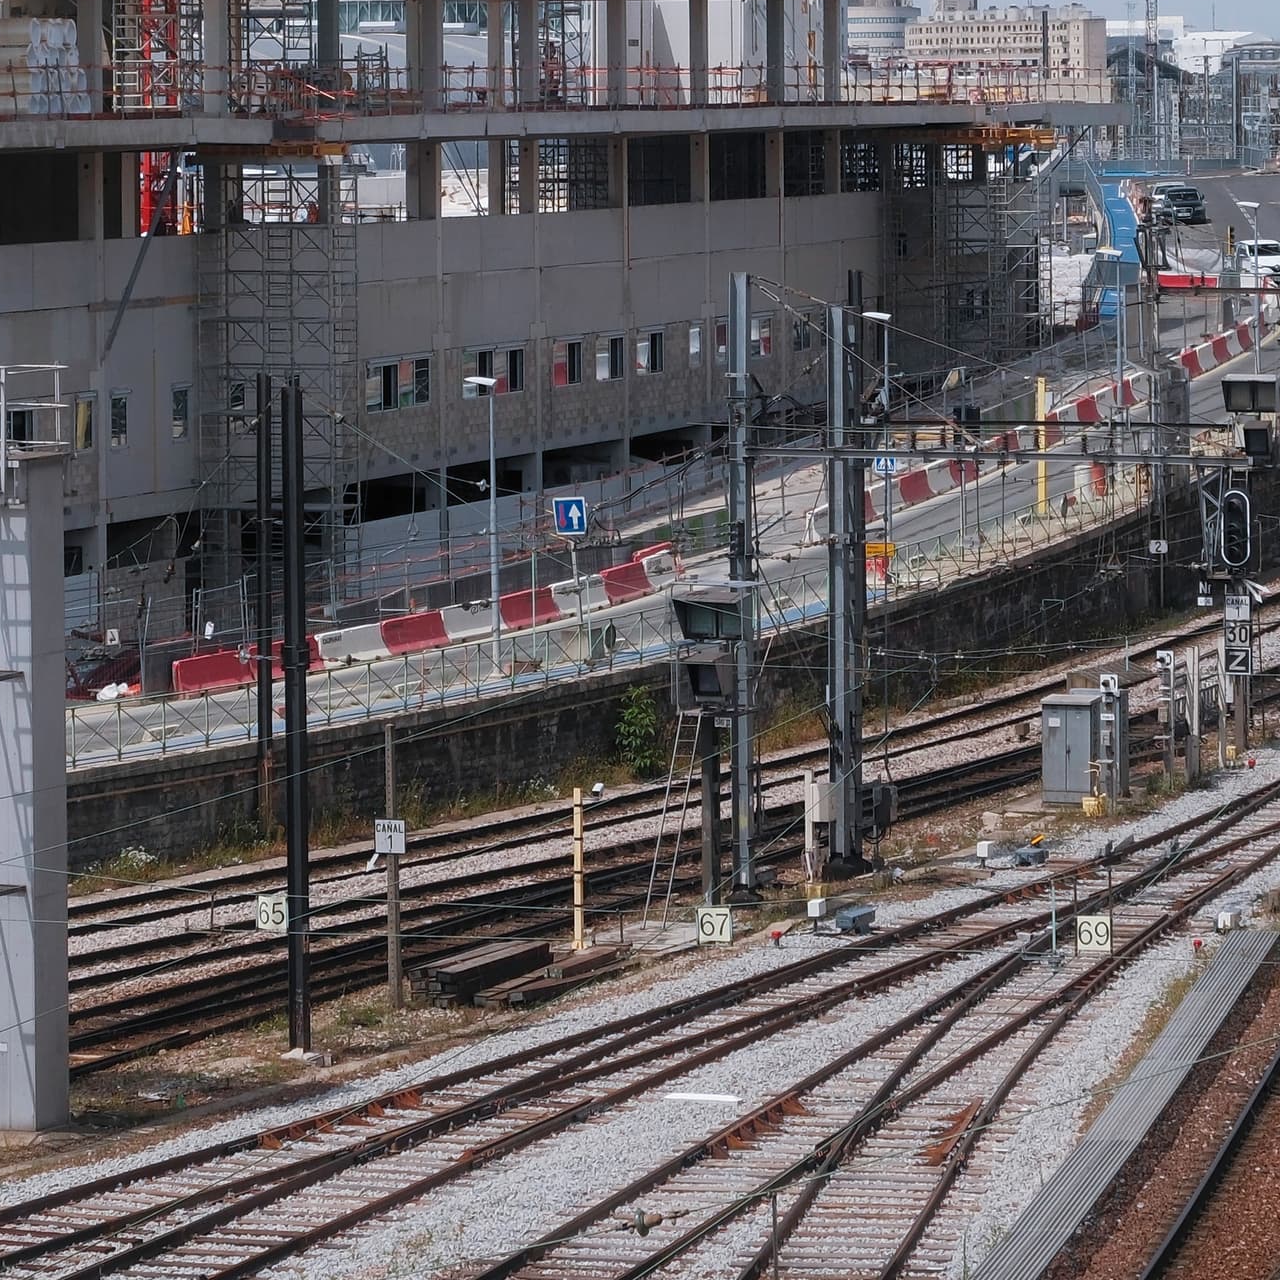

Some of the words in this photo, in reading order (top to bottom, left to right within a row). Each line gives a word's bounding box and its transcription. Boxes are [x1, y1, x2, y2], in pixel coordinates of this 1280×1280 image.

[1155, 541, 1162, 553] 2
[1226, 598, 1248, 606] CANAL
[1235, 606, 1240, 618] 1
[1227, 624, 1248, 643] 30
[1229, 651, 1247, 671] Z
[375, 823, 404, 834] CANAL
[387, 834, 393, 850] 1
[259, 901, 285, 925] 65
[700, 912, 728, 937] 67
[1078, 920, 1109, 946] 69
